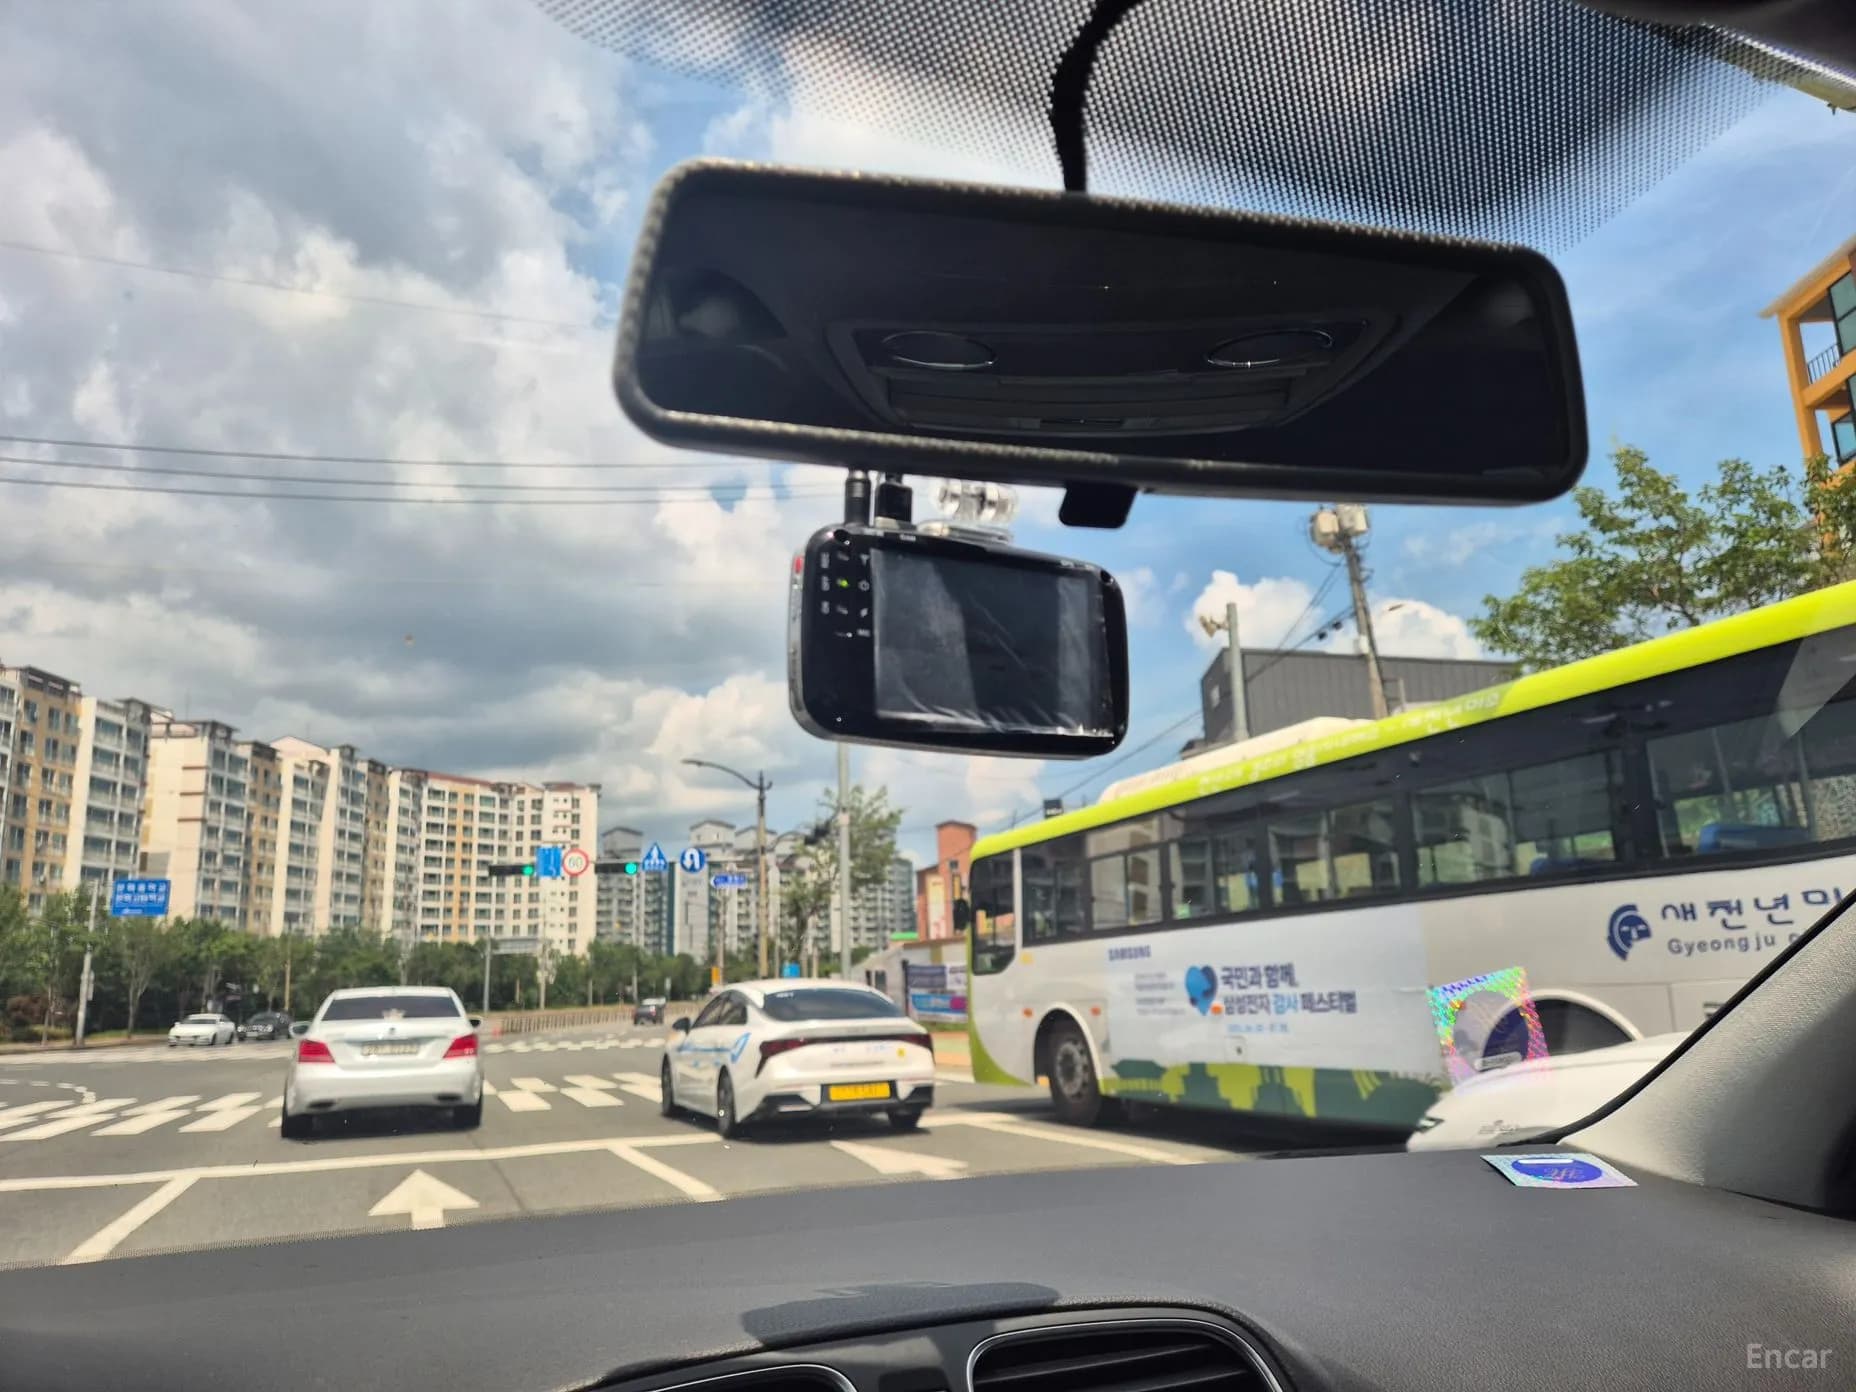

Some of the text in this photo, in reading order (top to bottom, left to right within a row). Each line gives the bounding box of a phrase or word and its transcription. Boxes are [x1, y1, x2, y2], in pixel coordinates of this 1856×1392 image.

[568, 856, 583, 869] 60
[1108, 945, 1151, 961] SAMSUNG
[1667, 933, 1777, 957] Gyeongju
[1221, 966, 1262, 989] 국민과
[1224, 994, 1271, 1015] 삼성전자
[1272, 993, 1298, 1015] 감사
